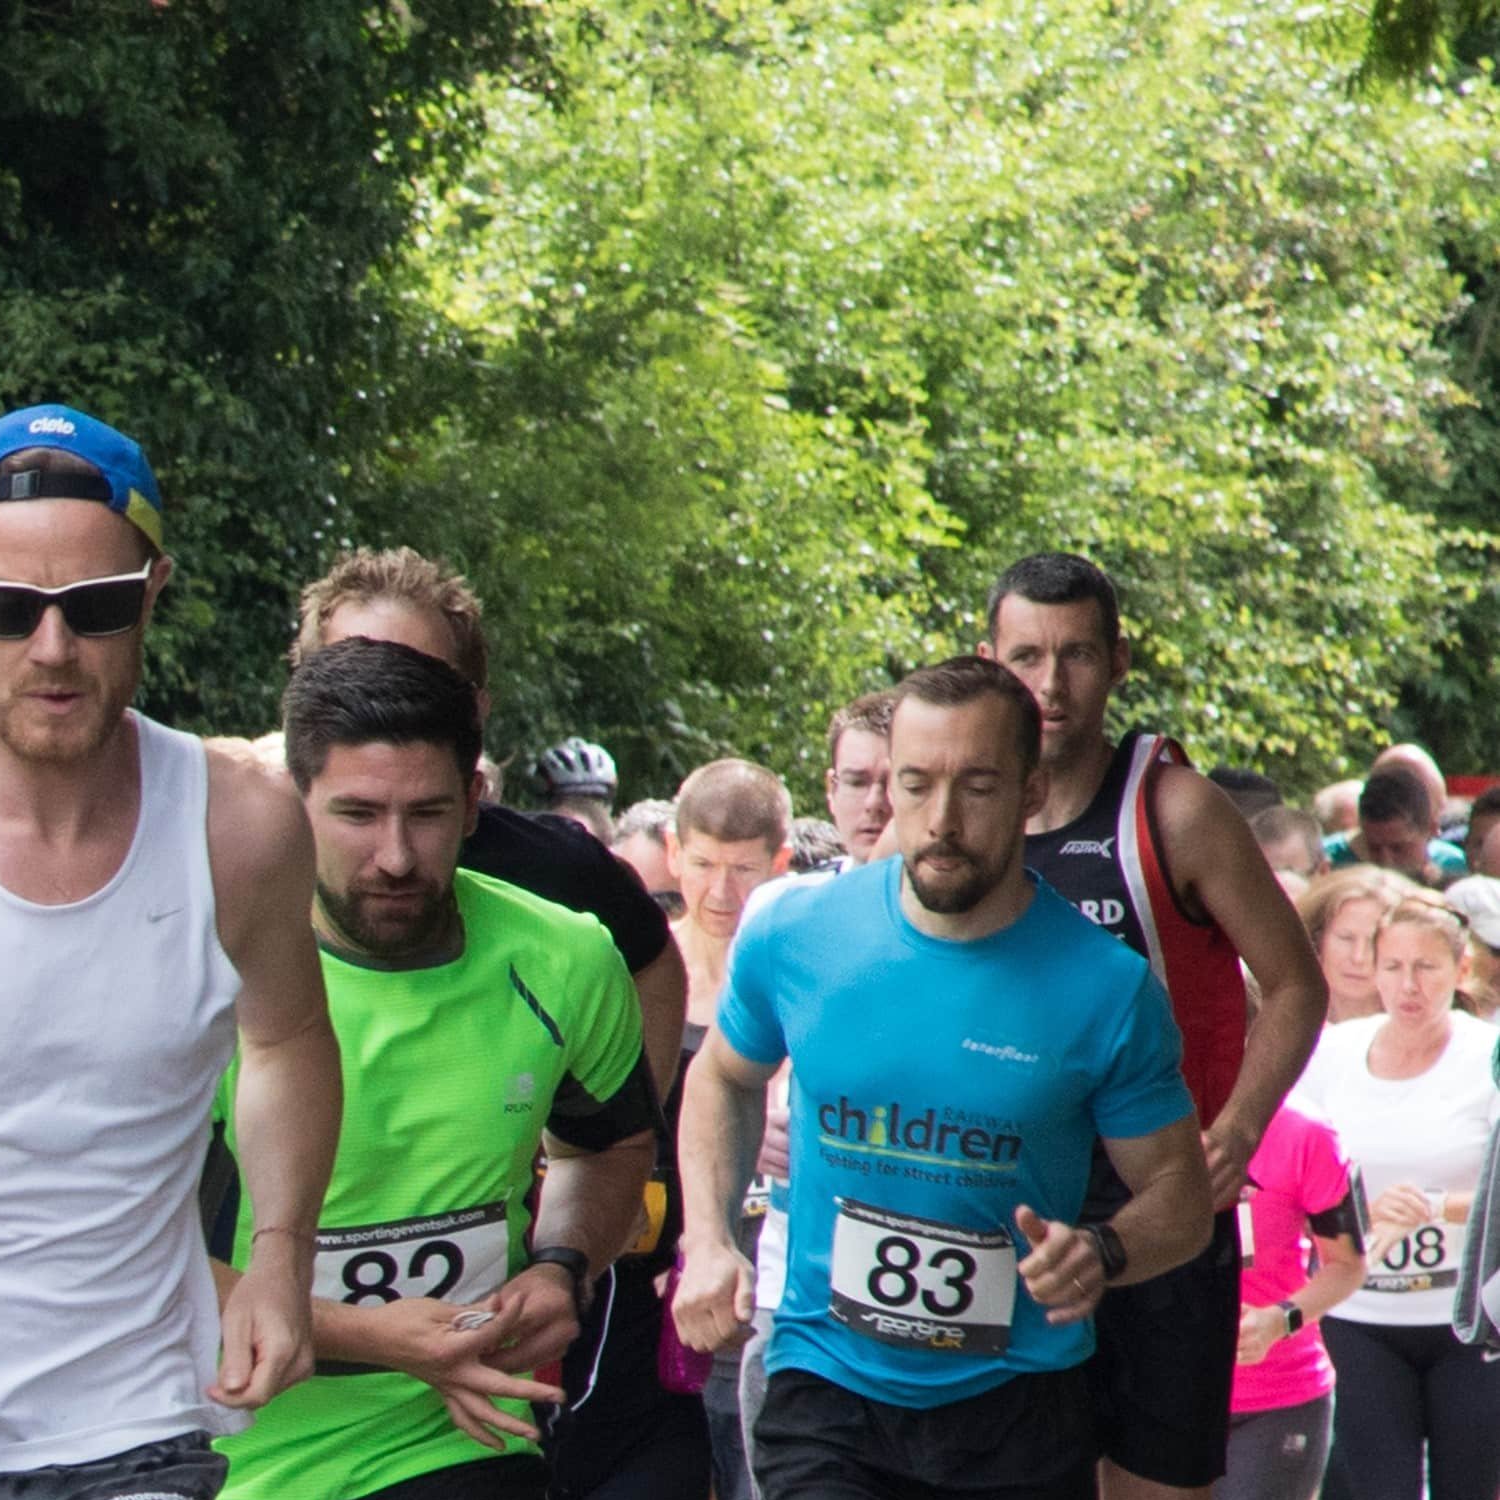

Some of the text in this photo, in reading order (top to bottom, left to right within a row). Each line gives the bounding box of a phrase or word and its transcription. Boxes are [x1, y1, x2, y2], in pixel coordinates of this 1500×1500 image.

[1070, 899, 1125, 925] RD
[819, 1096, 1023, 1162] children
[341, 1240, 466, 1307] 82
[867, 1236, 978, 1317] 83
[1383, 1226, 1446, 1271] 08
